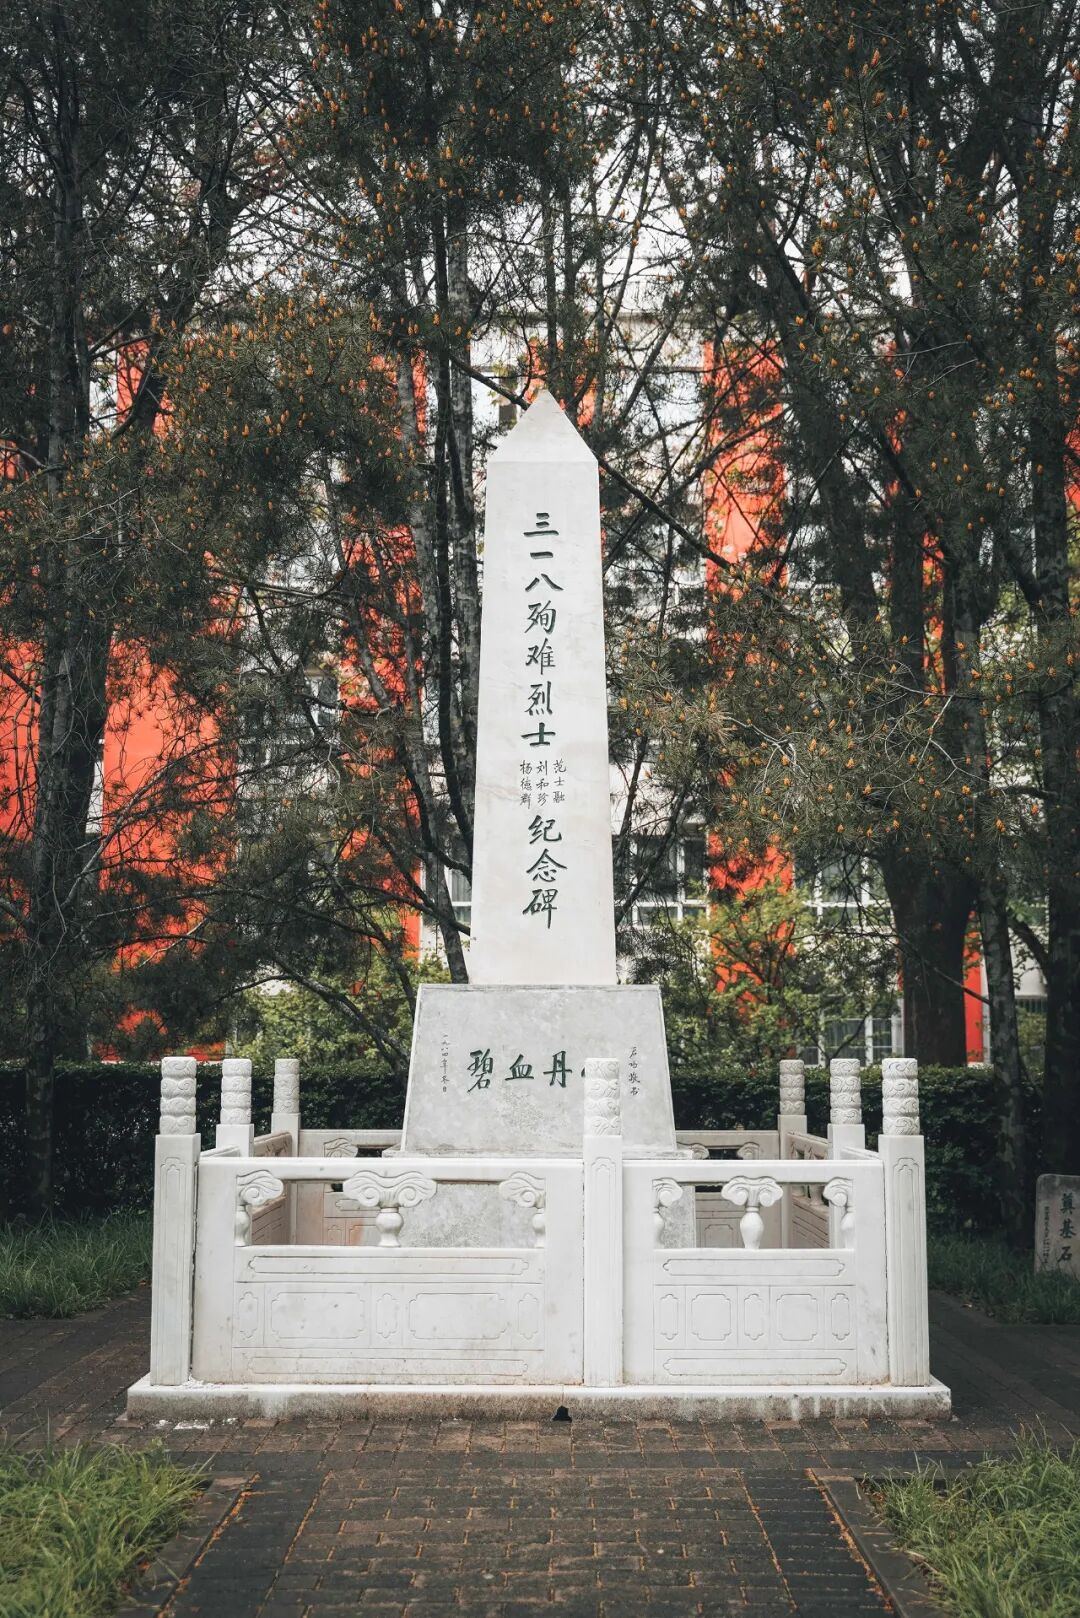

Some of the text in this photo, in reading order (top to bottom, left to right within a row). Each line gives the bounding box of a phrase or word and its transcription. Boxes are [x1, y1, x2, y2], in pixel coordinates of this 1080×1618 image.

[521, 512, 564, 747] 三一八殉难烈士
[536, 759, 549, 806] 刘和珍
[522, 815, 567, 929] 纪念碑
[467, 1048, 586, 1093] 碧血丹
